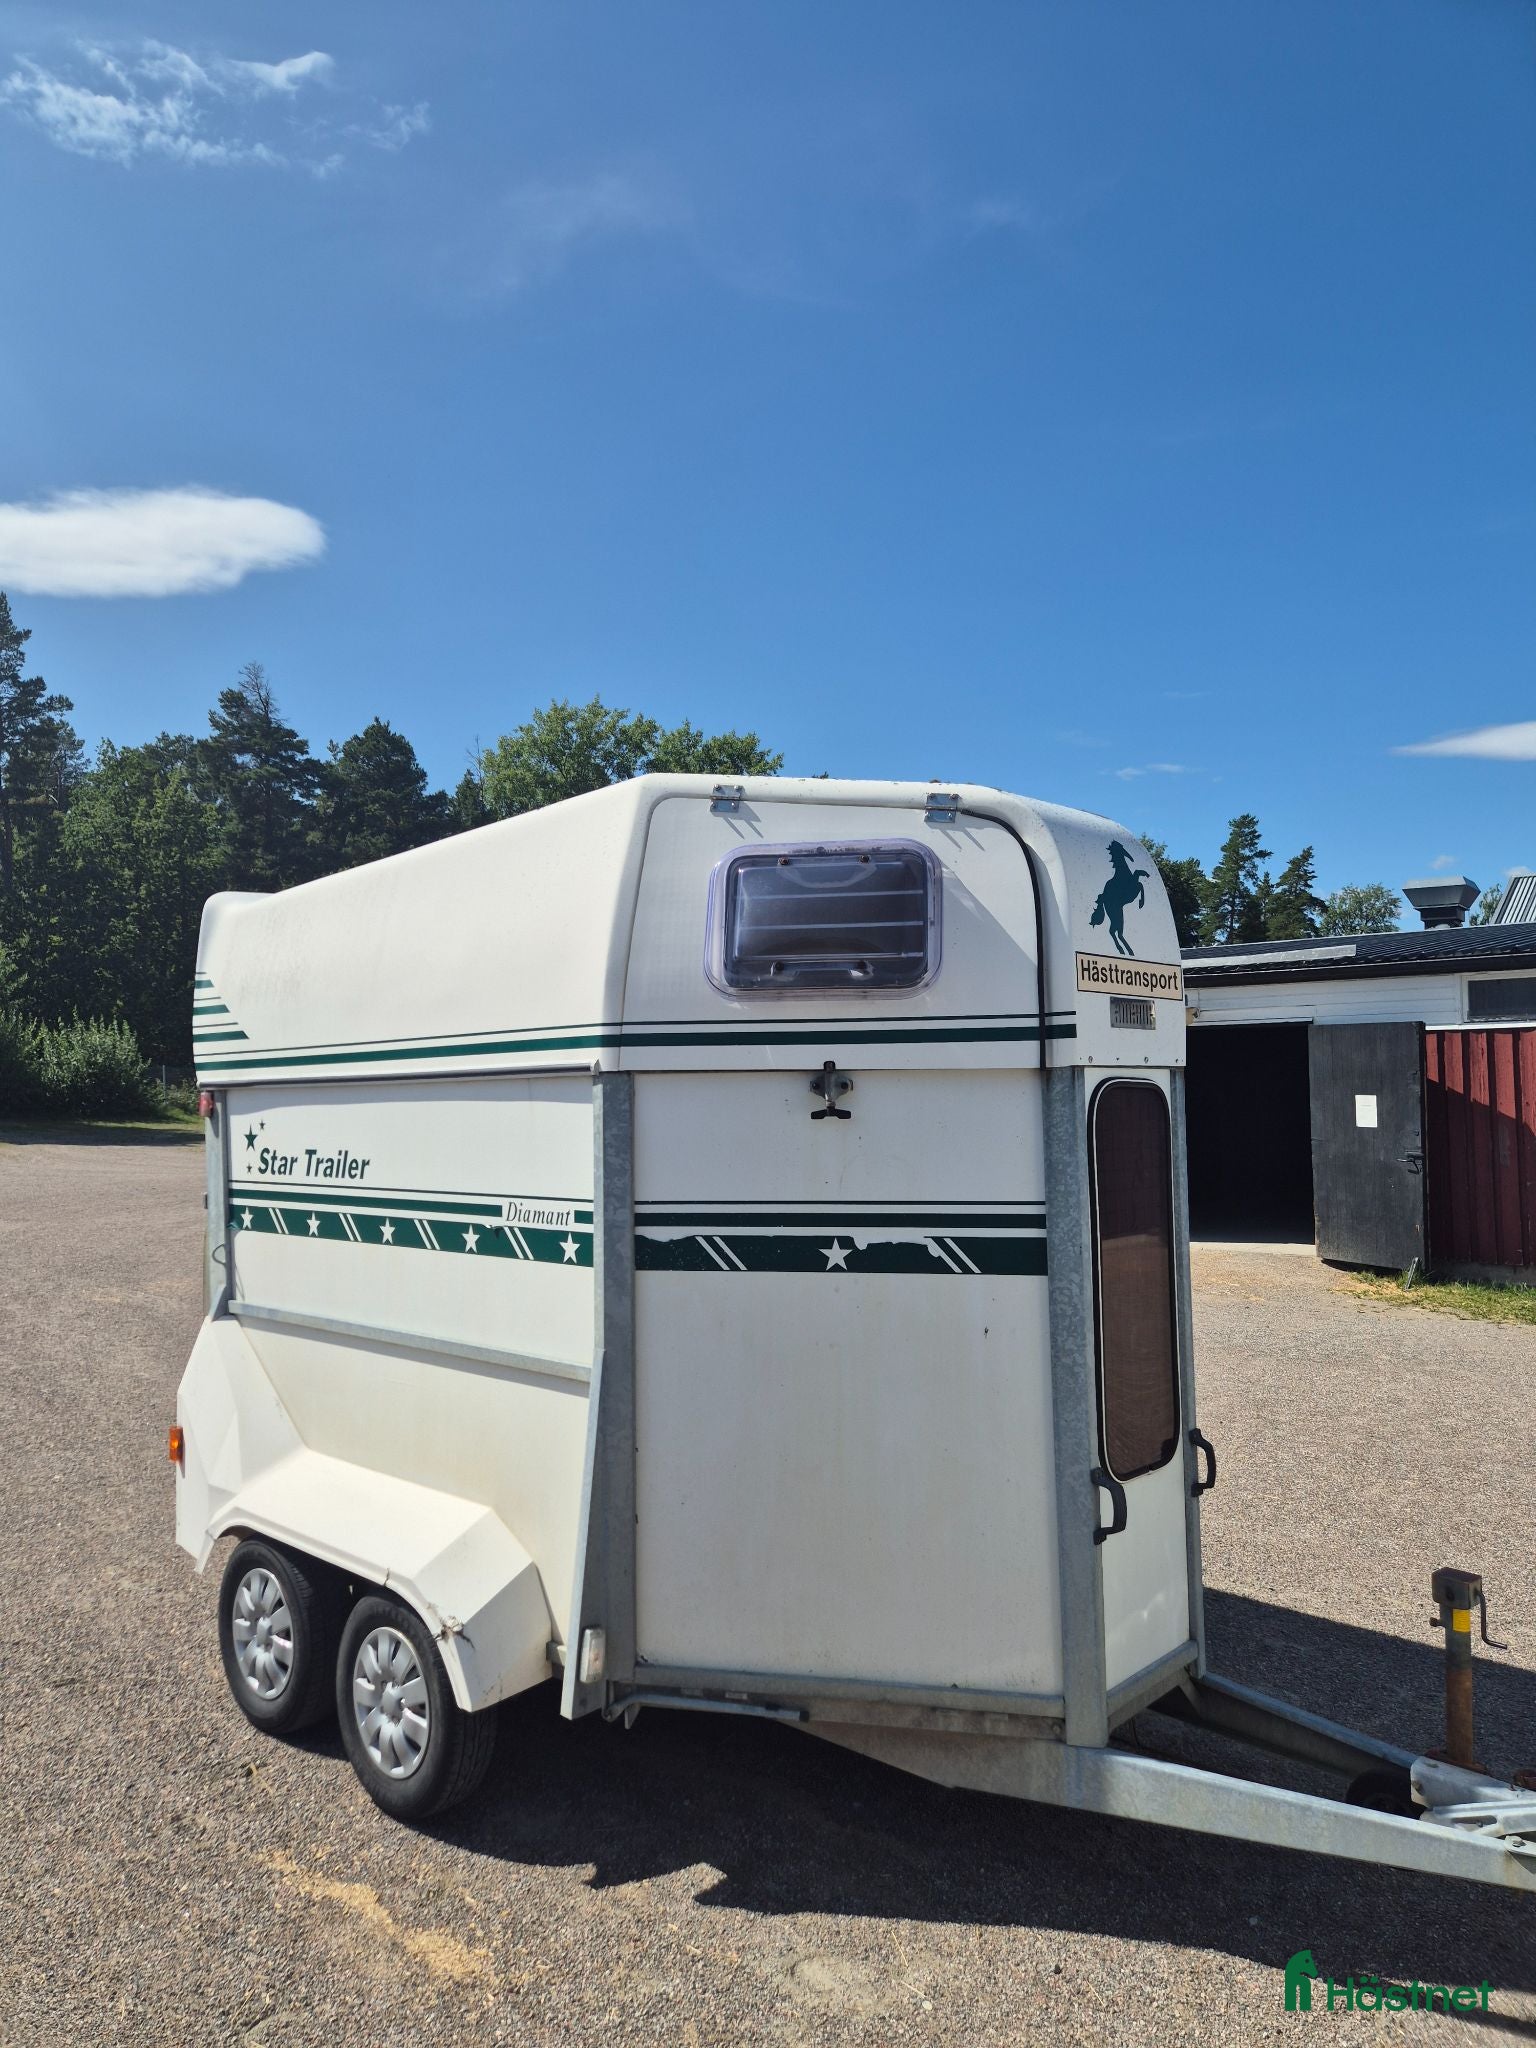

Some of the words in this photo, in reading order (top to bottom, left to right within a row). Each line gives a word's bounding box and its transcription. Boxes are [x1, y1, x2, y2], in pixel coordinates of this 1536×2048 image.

[1080, 958, 1178, 992] Hästtransport
[257, 1147, 298, 1176] Star
[304, 1149, 370, 1180] Trailer
[506, 1201, 571, 1227] Diamant
